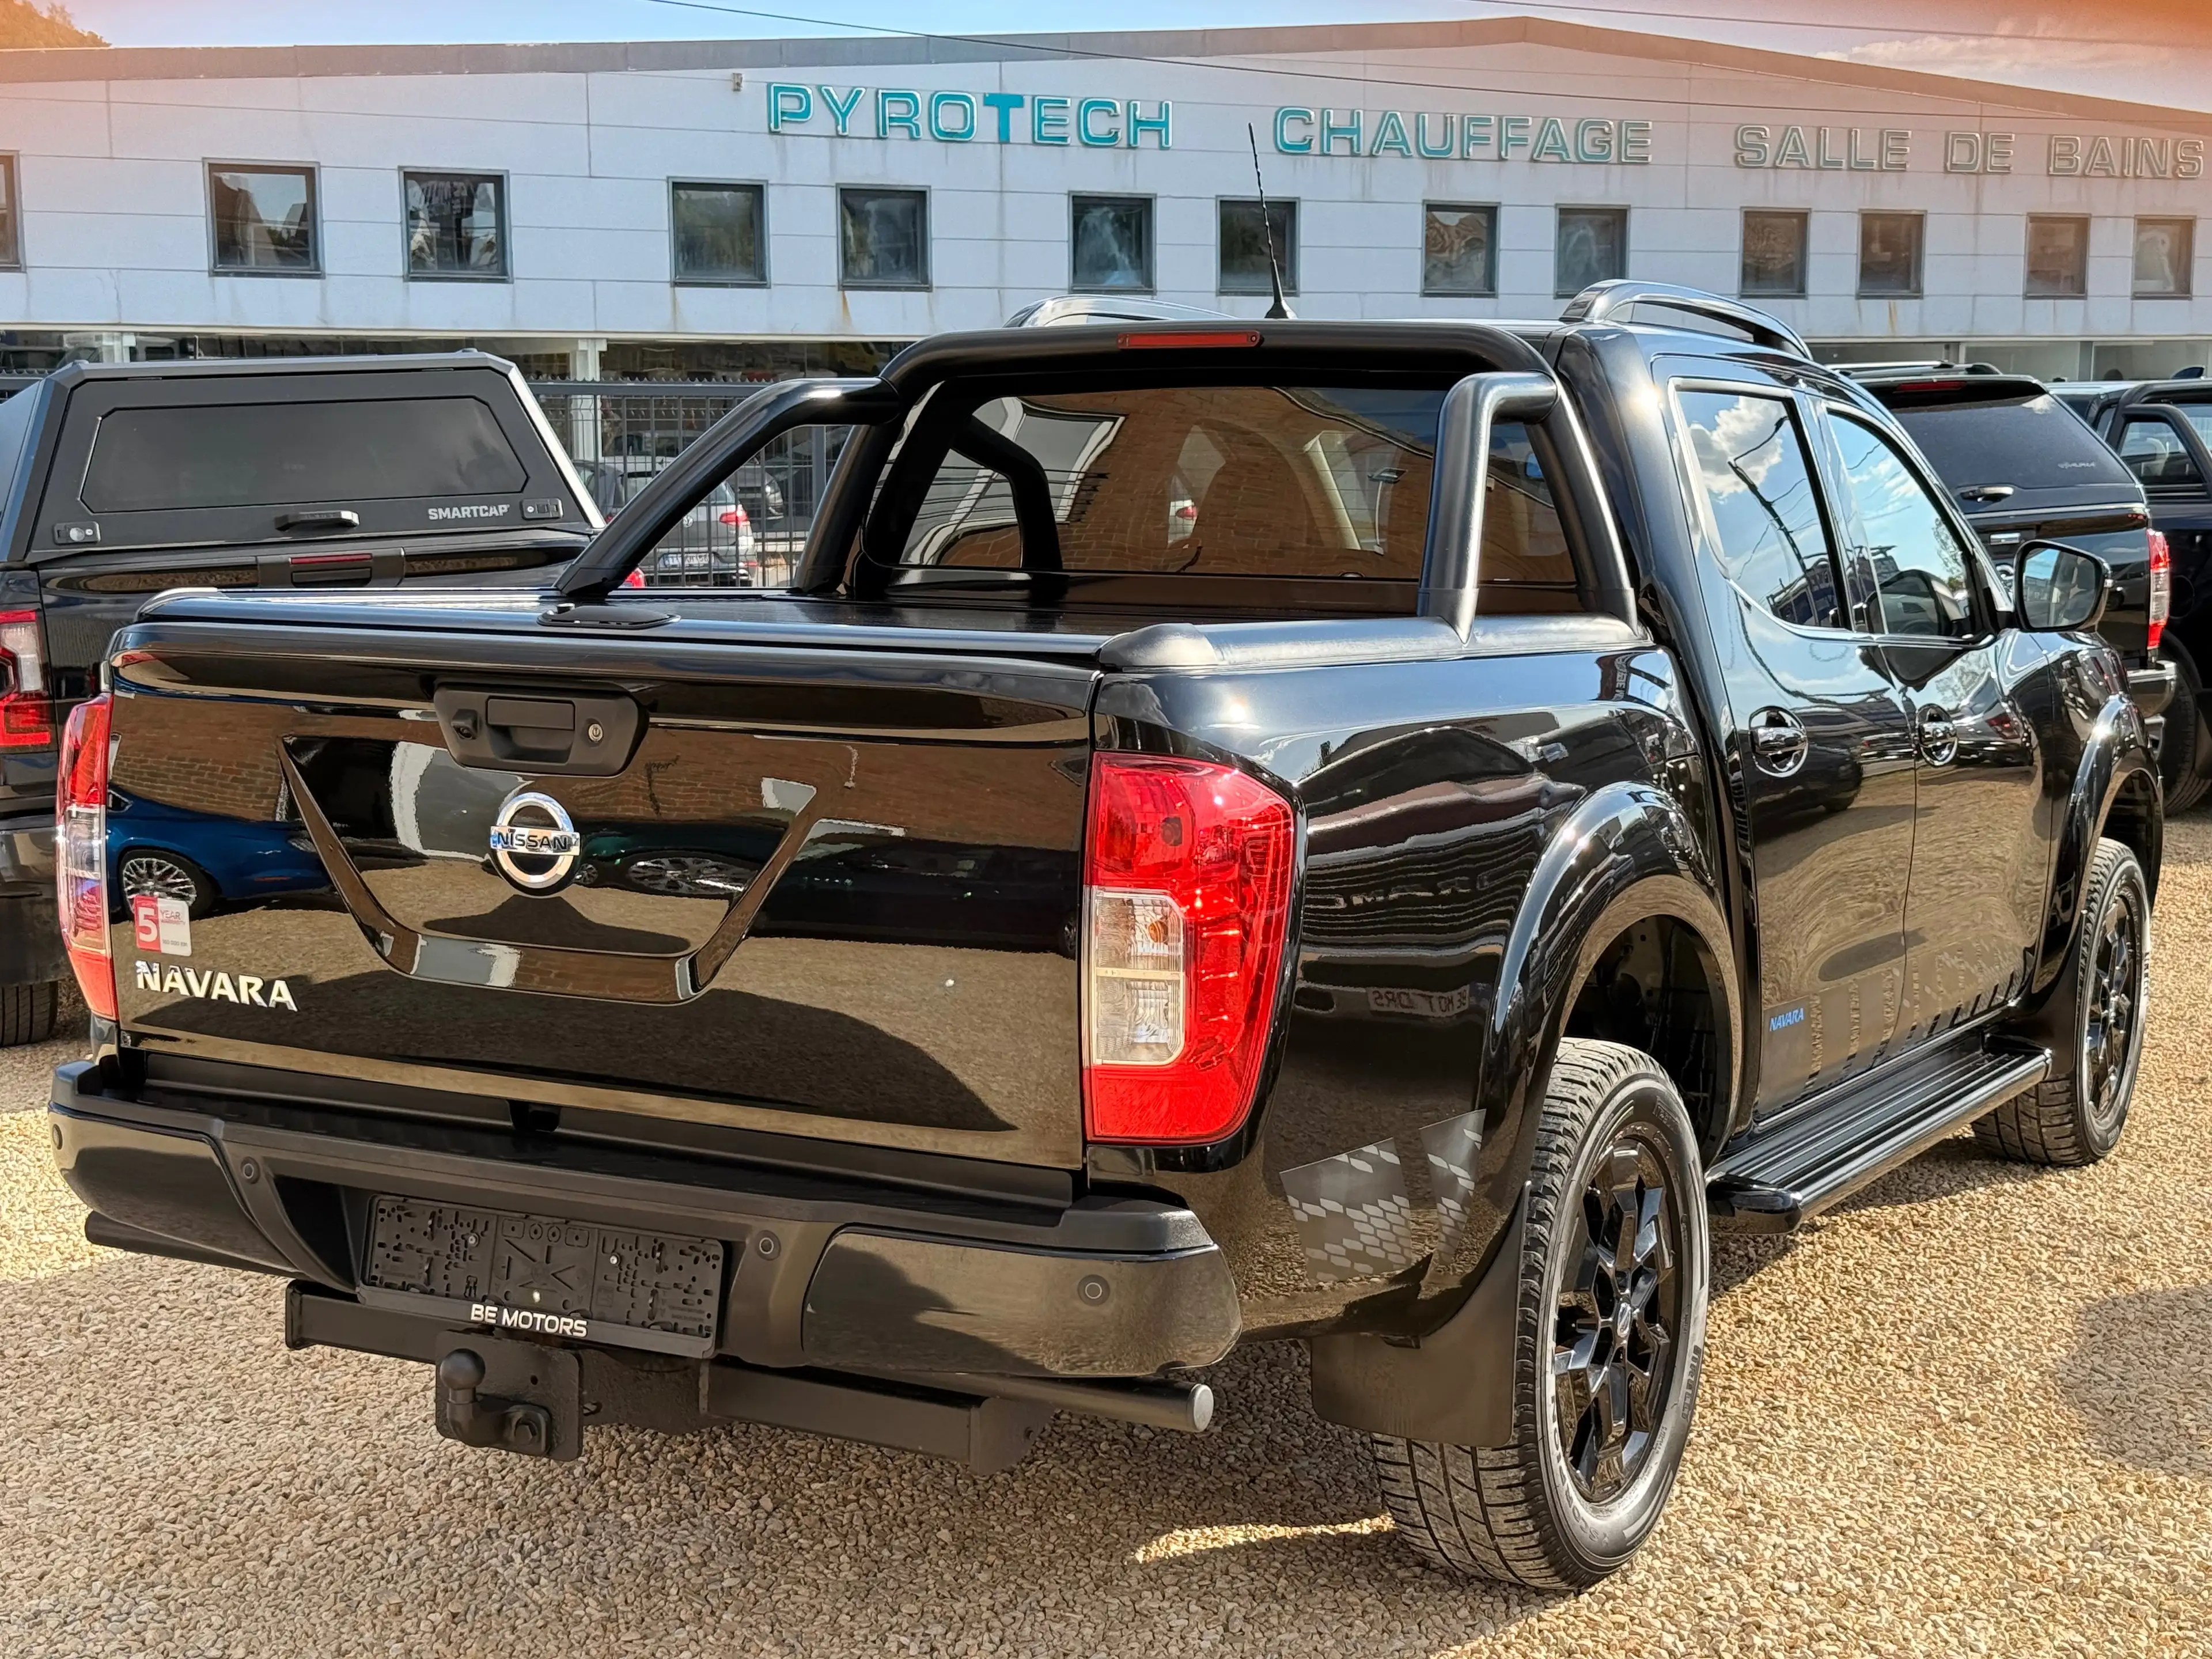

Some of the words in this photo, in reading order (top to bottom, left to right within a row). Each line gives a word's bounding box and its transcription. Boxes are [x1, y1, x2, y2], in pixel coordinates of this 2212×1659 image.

[767, 82, 1173, 149] PYROTECH
[1274, 107, 1652, 164] CHAUFFAGE
[1735, 126, 1912, 172] SALLE
[1944, 131, 2016, 174] DE
[2048, 135, 2203, 179] BAINS
[428, 505, 510, 520] SMARTCAP
[498, 831, 569, 850] NISSAN
[139, 907, 158, 942] 5
[161, 910, 181, 920] YEAR
[135, 959, 298, 1012] NAVARA
[1769, 1007, 1804, 1032] NAVARA
[471, 1303, 498, 1324] BE
[502, 1308, 587, 1337] MOTORS
